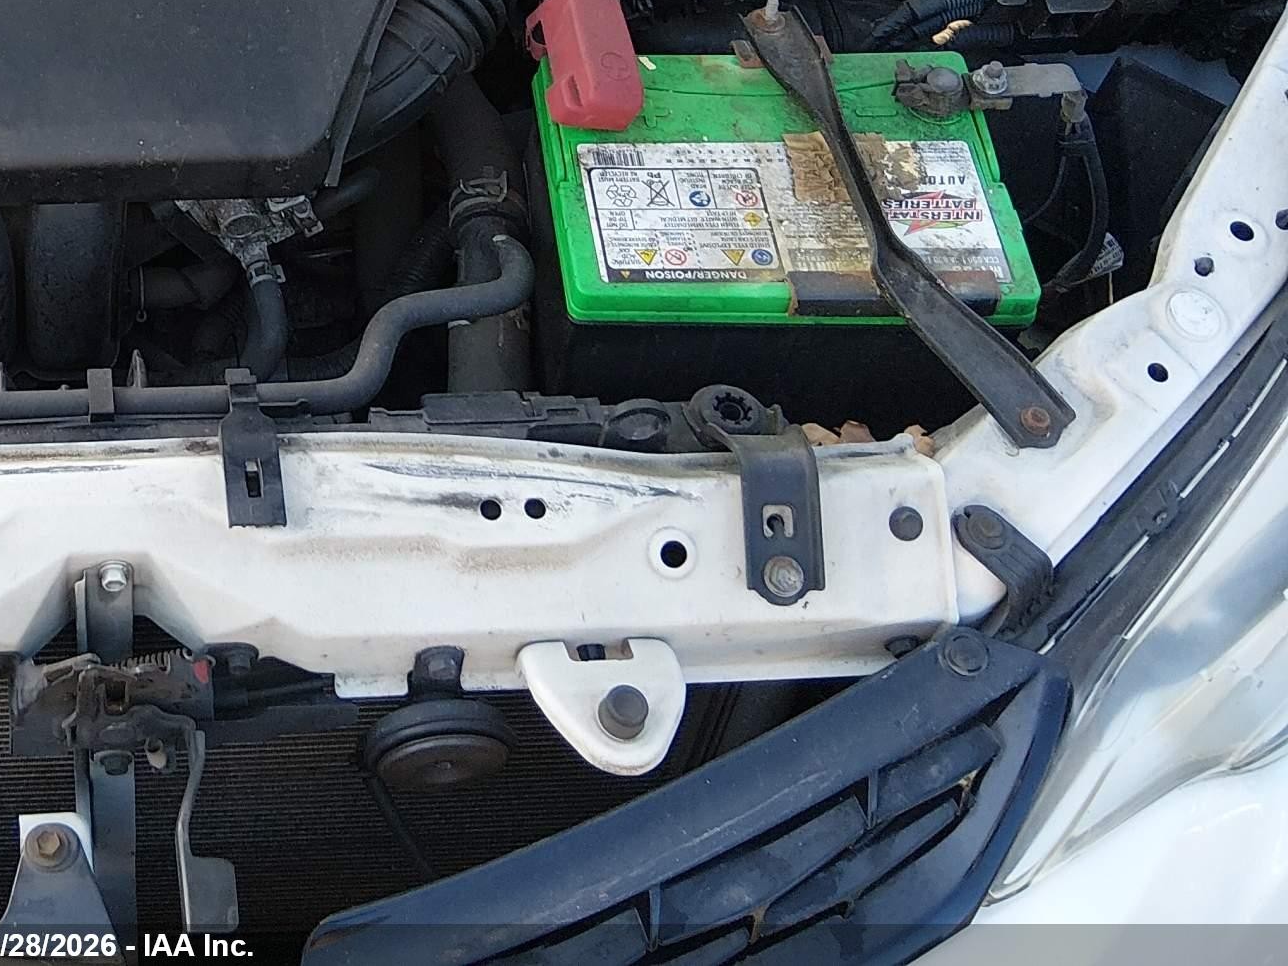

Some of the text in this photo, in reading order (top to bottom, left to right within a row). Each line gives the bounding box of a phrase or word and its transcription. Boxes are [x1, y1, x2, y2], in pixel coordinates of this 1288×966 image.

[882, 199, 974, 210] BATTERIES
[886, 211, 981, 221] INTERSTAT
[644, 269, 747, 279] DANGER/POISON
